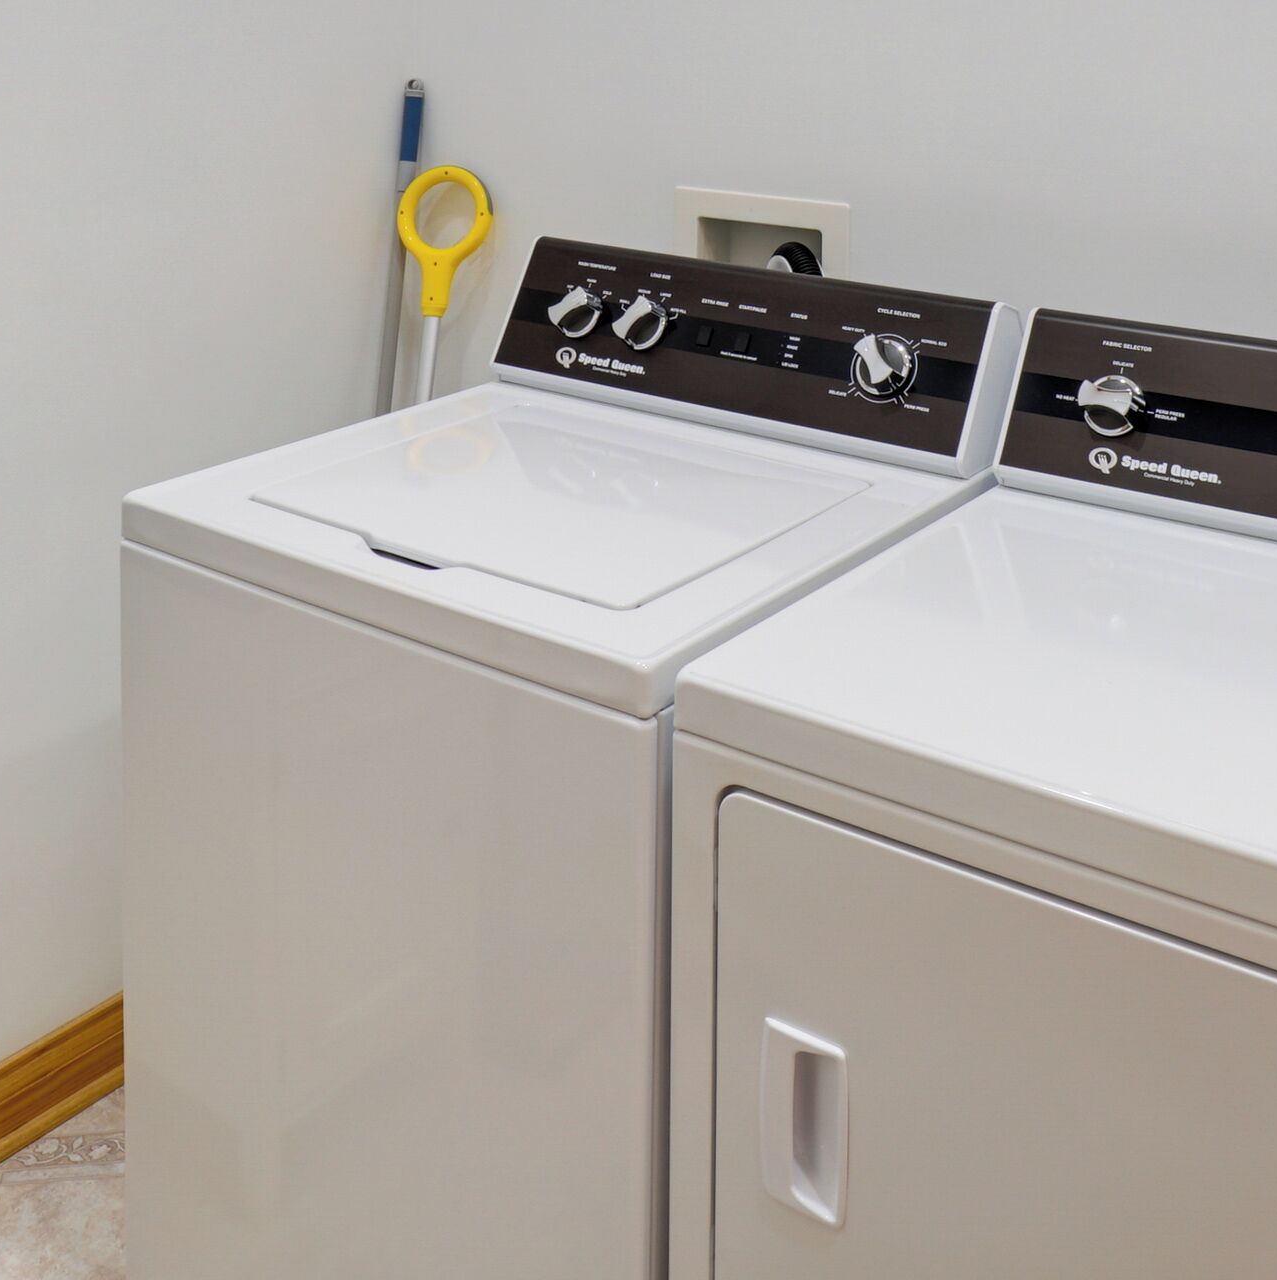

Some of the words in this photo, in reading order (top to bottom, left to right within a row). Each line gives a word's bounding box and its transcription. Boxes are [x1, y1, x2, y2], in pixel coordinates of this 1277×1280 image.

[877, 307, 893, 315] CYCLE
[894, 309, 921, 319] SELECTION
[1102, 340, 1122, 348] FABRIC
[1123, 342, 1152, 352] SELECTOR
[578, 352, 610, 367] Speed
[611, 359, 644, 375] Queen
[1112, 360, 1134, 368] DELICATE
[1121, 455, 1167, 474] Speed
[1170, 464, 1219, 483] Queen
[1143, 472, 1170, 481] Commercial
